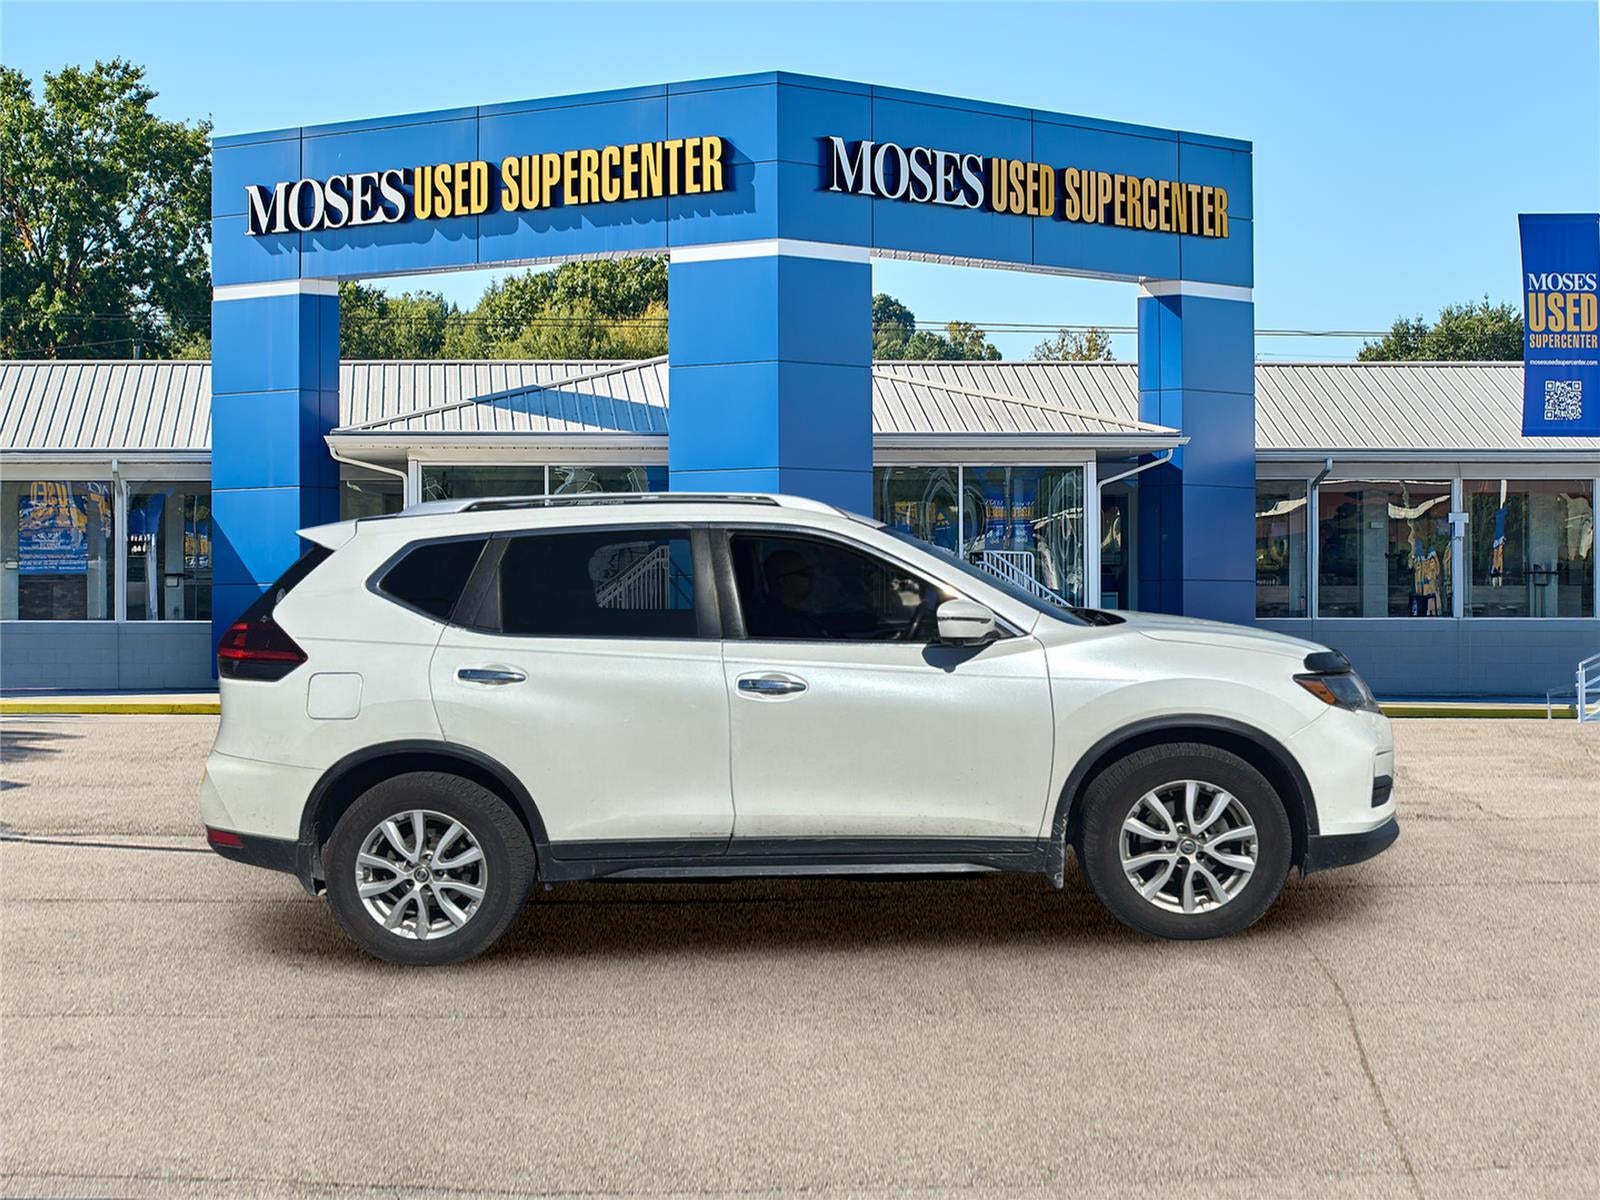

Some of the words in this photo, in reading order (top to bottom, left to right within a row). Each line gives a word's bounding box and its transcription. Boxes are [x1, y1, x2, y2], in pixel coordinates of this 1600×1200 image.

[244, 169, 406, 236] MOSES
[413, 160, 488, 220] USED
[500, 135, 724, 212] SUPERCENTER
[829, 136, 984, 208] MOSES
[991, 157, 1056, 217] USED
[1065, 167, 1229, 238] SUPERCENTER
[1528, 273, 1597, 291] MOSES
[1528, 293, 1598, 332] USED
[1529, 334, 1598, 349] SUPERCENTER
